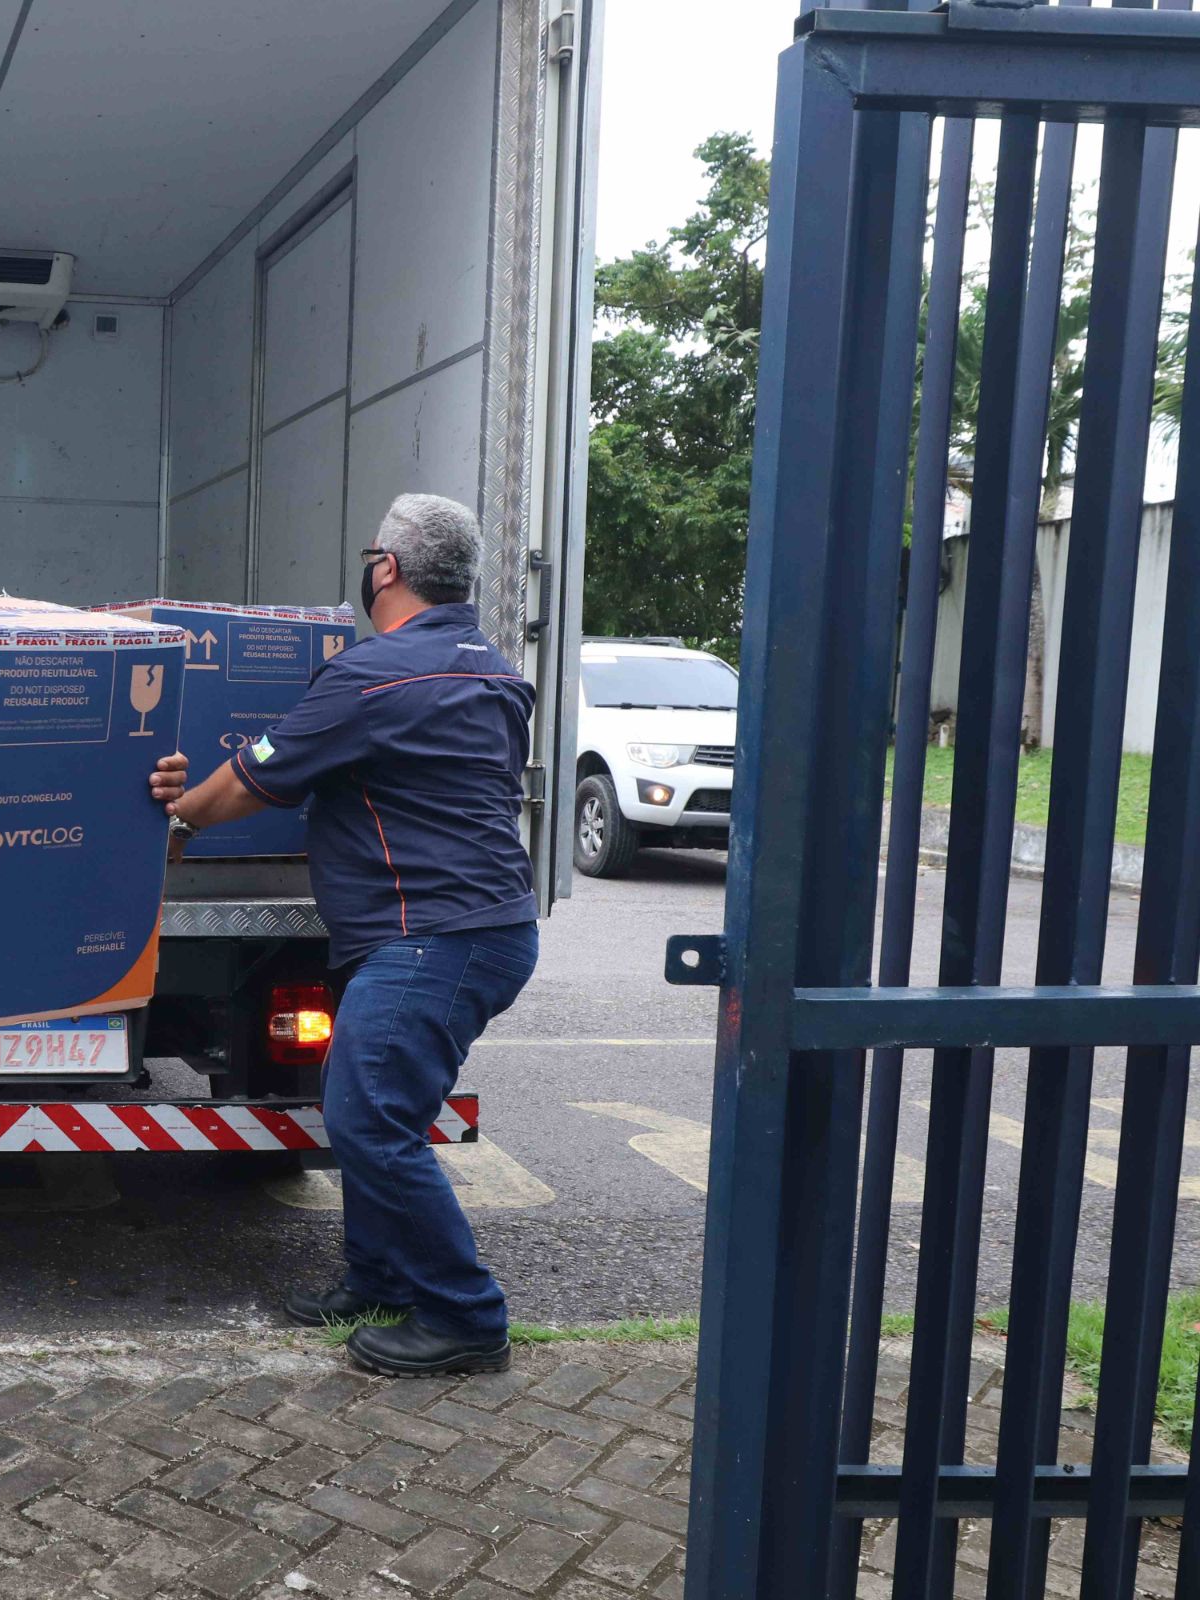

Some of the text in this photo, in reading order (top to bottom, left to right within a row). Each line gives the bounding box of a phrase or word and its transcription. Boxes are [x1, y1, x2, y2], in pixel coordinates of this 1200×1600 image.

[15, 656, 84, 665] NÃO DESCARTAR
[41, 667, 98, 677] REUTILIZÁVEL
[10, 685, 85, 694] DO NOT DISPOSED
[4, 696, 89, 706] REUSABLE PRODUCT
[21, 792, 73, 803] CONGELADO
[5, 826, 84, 848] VTCLOG
[84, 931, 126, 943] PERECÍVEL
[77, 942, 126, 954] PERISHABLE
